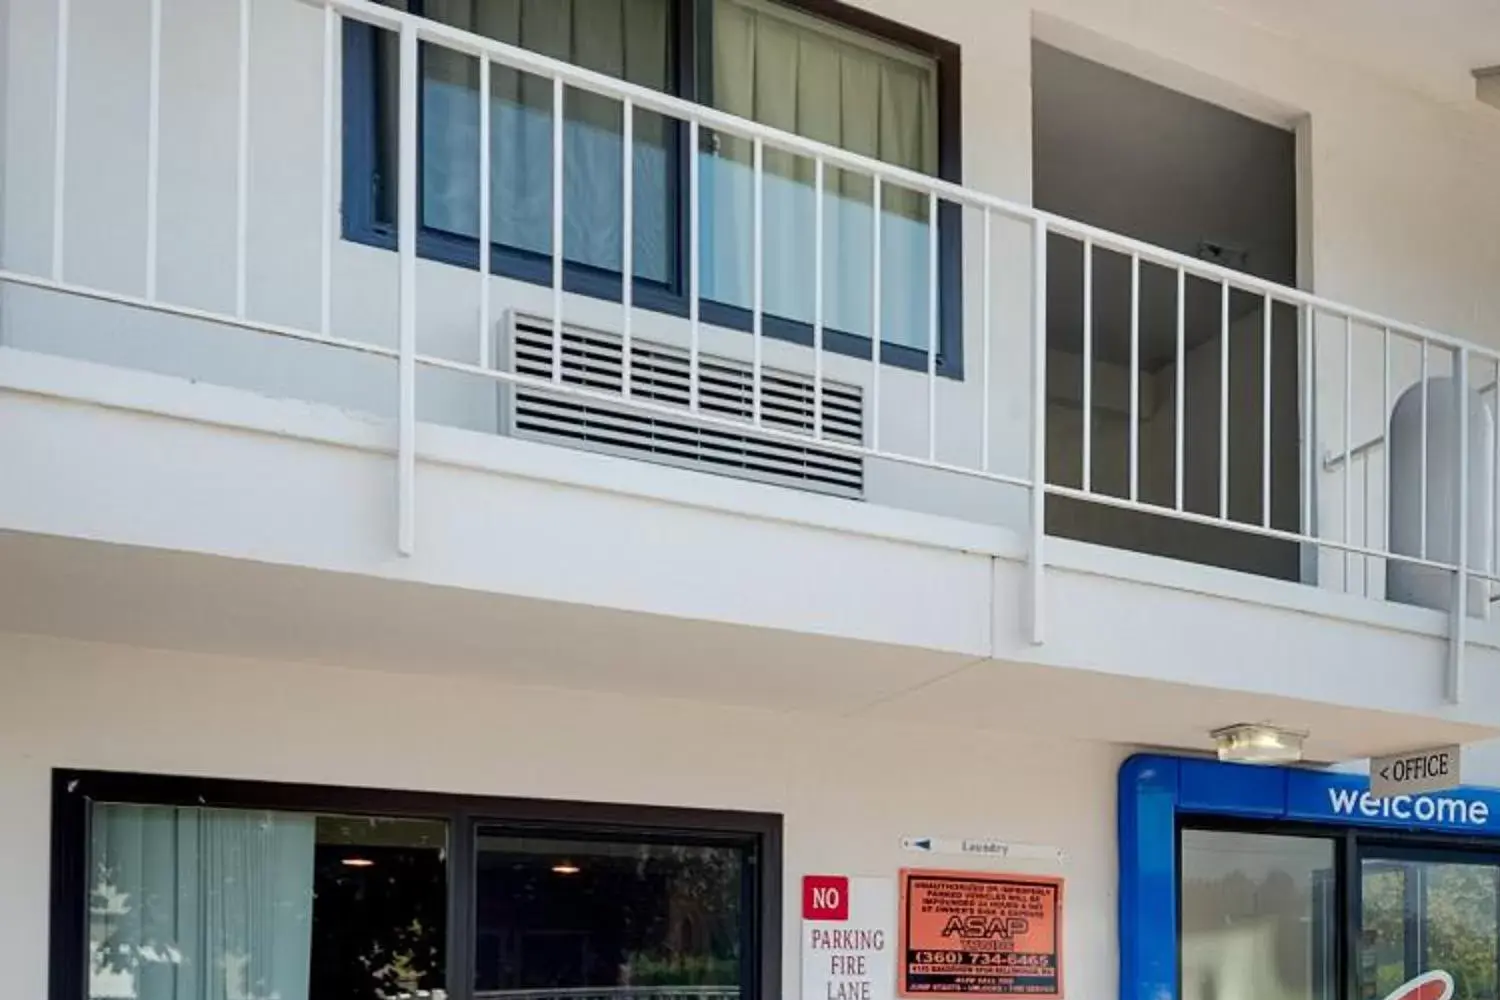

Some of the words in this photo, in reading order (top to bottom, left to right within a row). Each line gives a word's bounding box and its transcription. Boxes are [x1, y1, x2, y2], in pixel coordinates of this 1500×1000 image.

[1393, 753, 1449, 782] OFFICE
[1329, 787, 1489, 825] welcome
[812, 887, 840, 909] NO
[942, 915, 1029, 938] ASAP
[811, 928, 884, 950] PARKING
[831, 955, 865, 975] FIRE
[915, 951, 962, 963] (360)
[826, 981, 871, 1000] LANE
